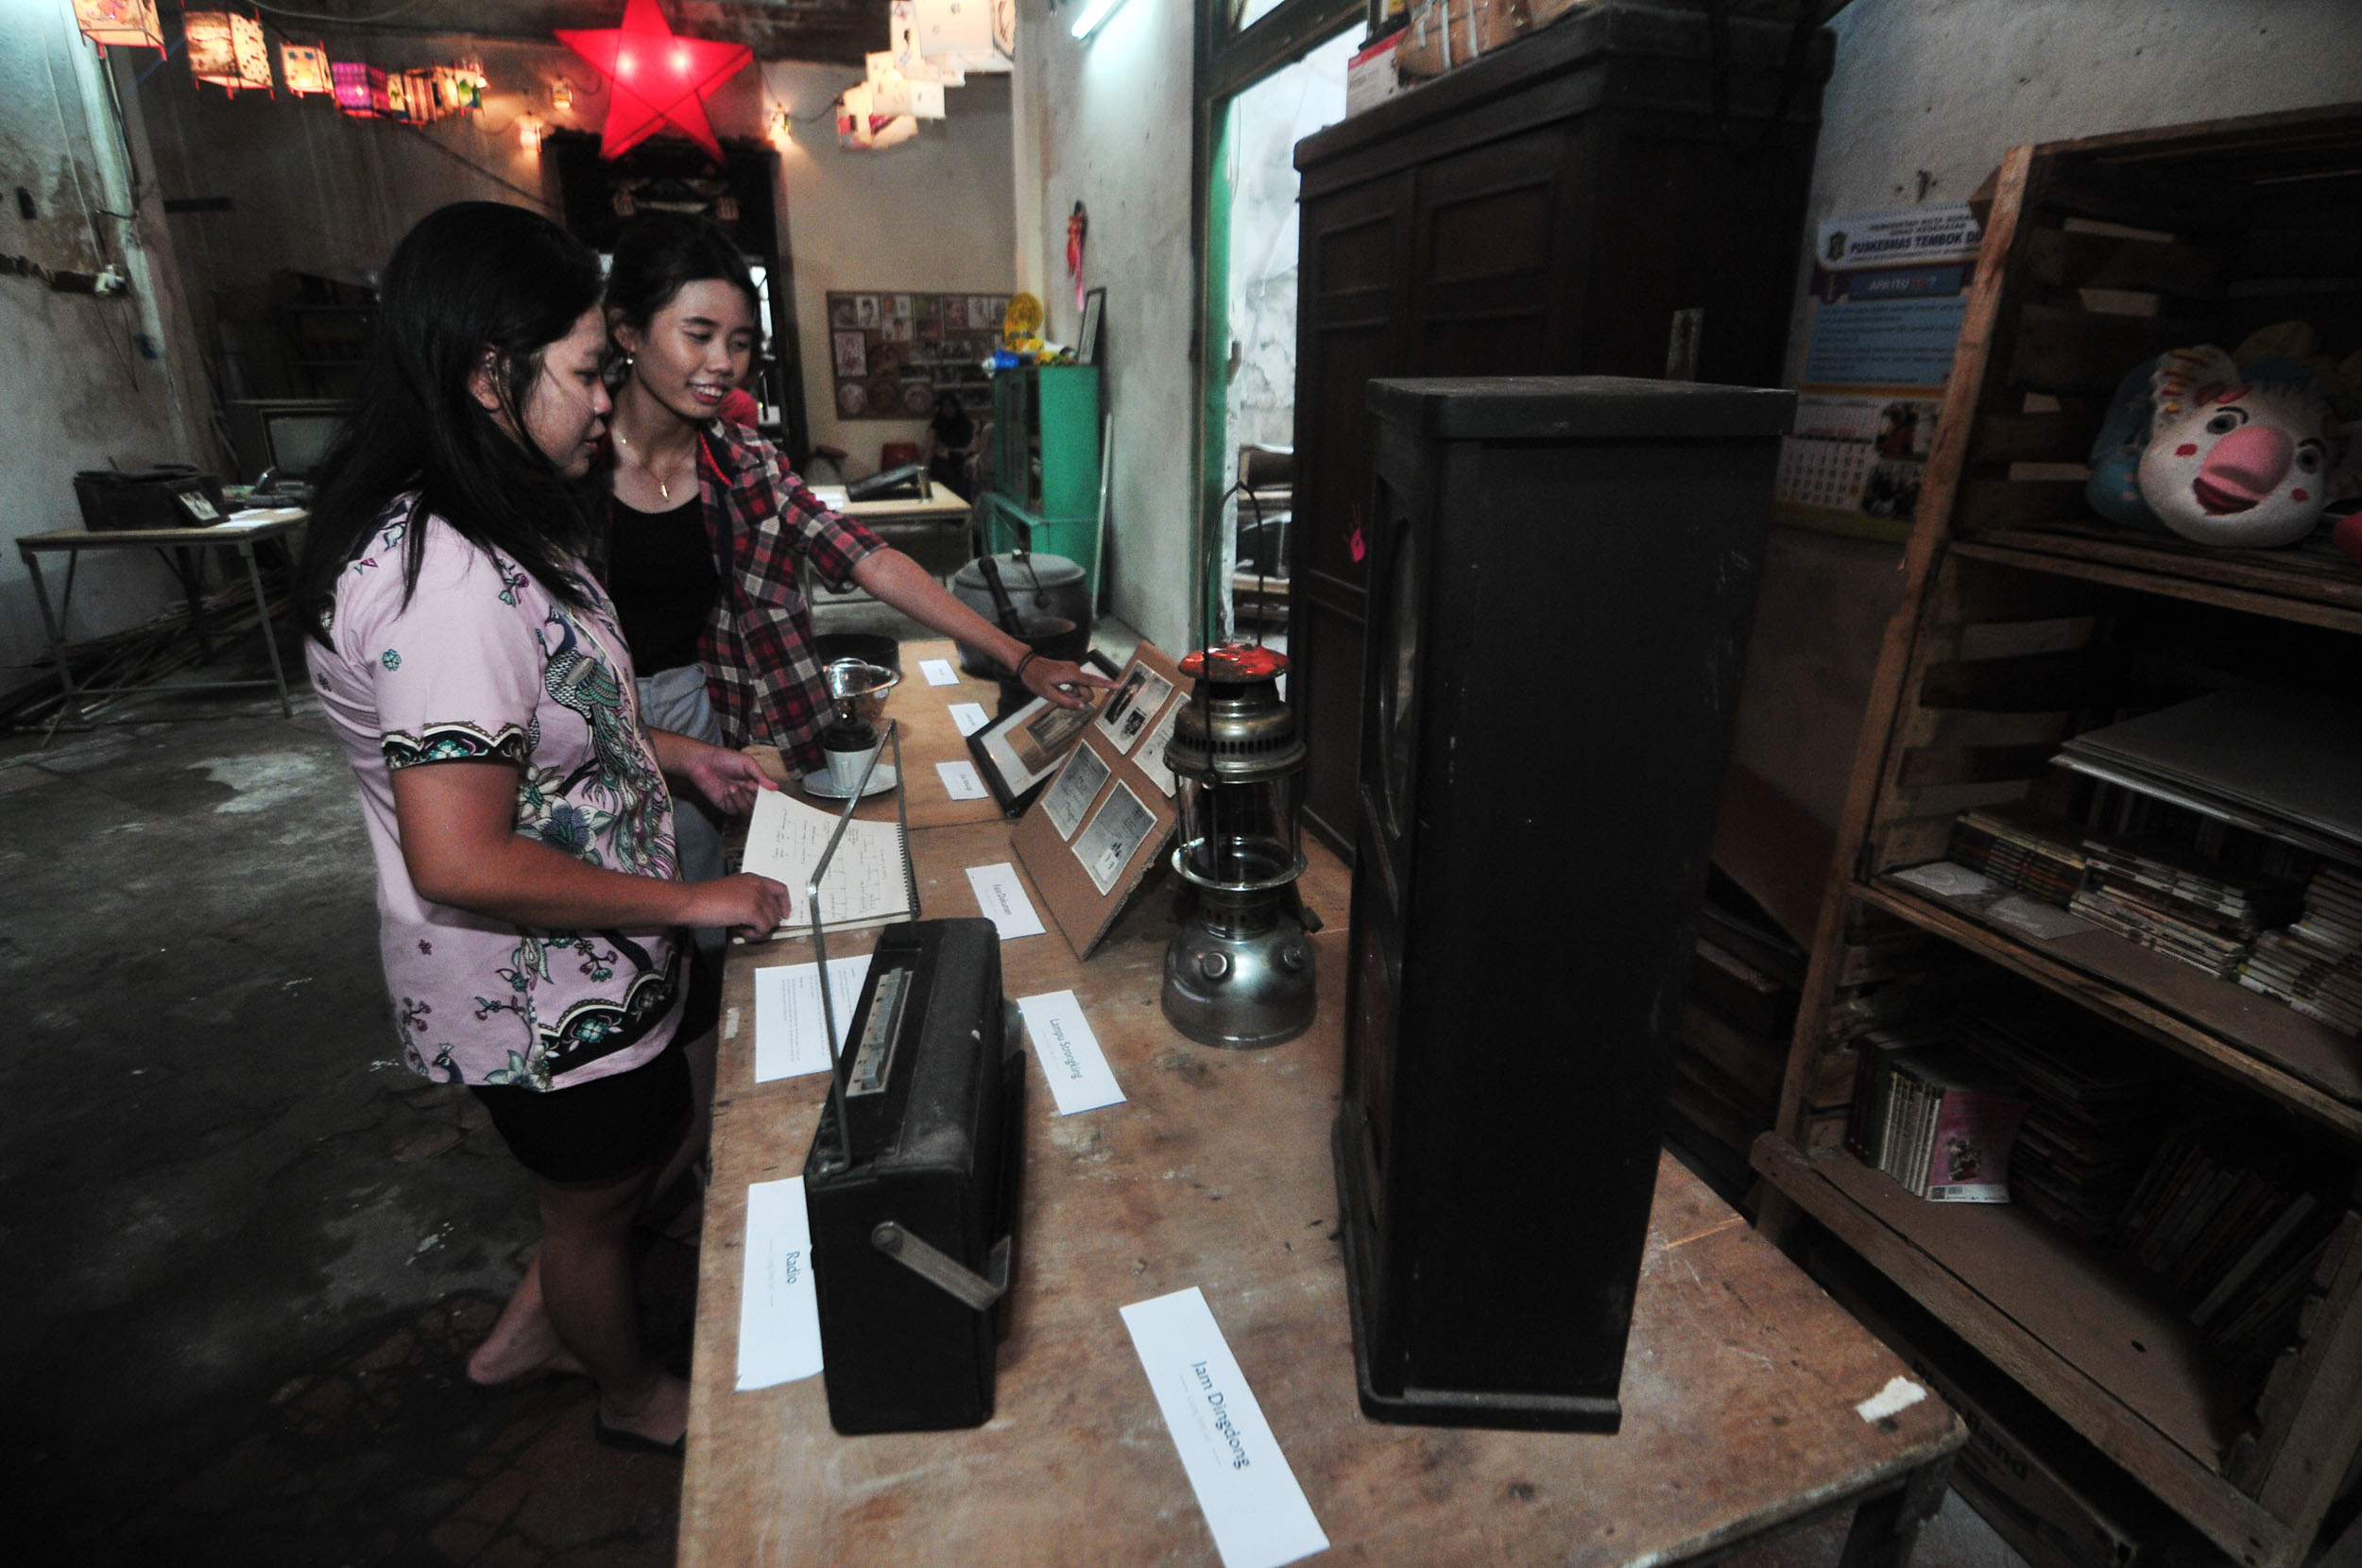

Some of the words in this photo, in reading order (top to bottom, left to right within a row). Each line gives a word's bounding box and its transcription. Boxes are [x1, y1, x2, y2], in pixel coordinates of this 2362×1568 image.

[1850, 236, 1911, 254] PUSKESMAS
[1915, 231, 1964, 247] TEMBOK
[1966, 230, 1984, 244] DU
[1050, 1018, 1064, 1042] Lampu
[1059, 1041, 1083, 1080] Strongking
[785, 1251, 801, 1285] Radio
[1191, 1360, 1213, 1390] Jam
[1208, 1391, 1250, 1471] Dingdong
